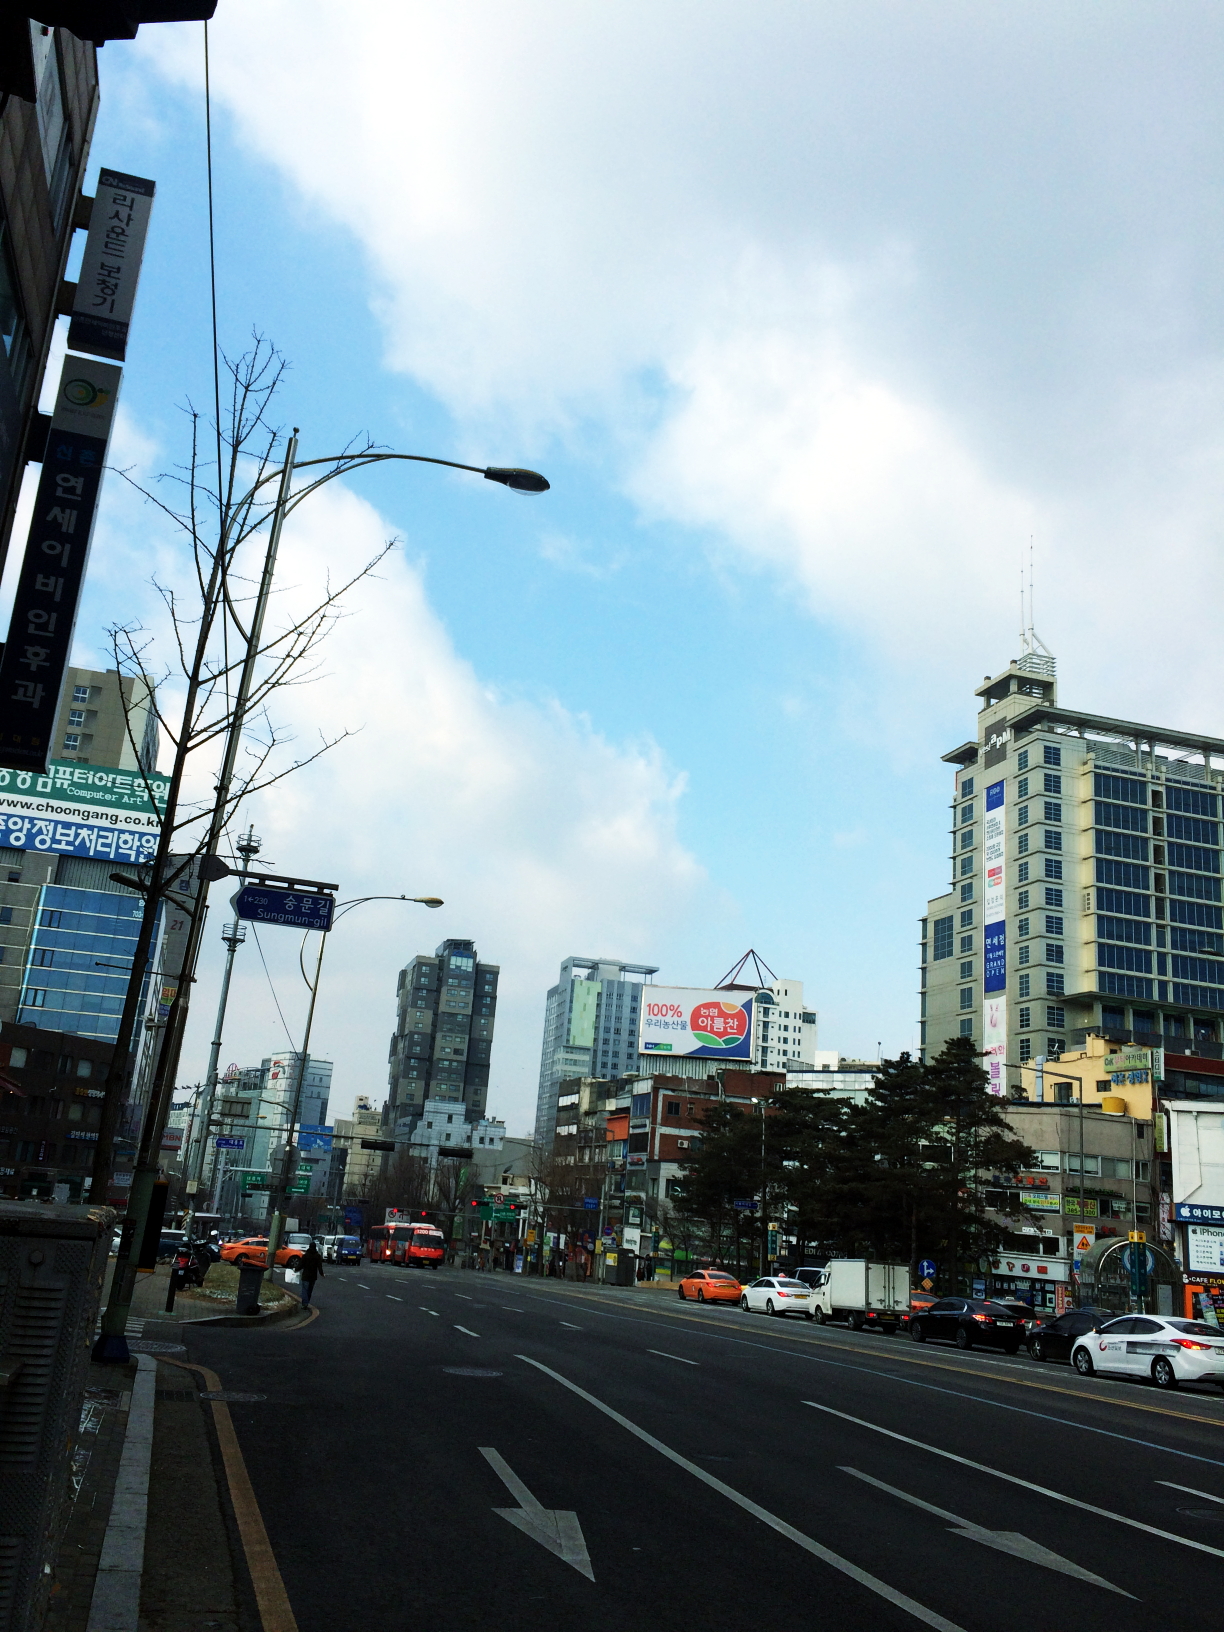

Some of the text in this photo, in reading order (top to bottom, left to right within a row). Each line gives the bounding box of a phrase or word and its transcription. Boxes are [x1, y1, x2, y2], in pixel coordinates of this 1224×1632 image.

[101, 192, 135, 258] 리사운드
[92, 263, 121, 314] 보청기
[10, 473, 86, 710] 연세이비인후과
[66, 786, 143, 805] Computer Art
[283, 895, 331, 916] 숭문길
[256, 908, 328, 928] Sungmun-gil
[985, 933, 1005, 949] 면세점
[986, 958, 1005, 969] GRAND
[986, 967, 1005, 978] OPEN
[646, 1003, 683, 1018] 100%
[700, 1007, 719, 1016] 농협
[645, 1018, 688, 1031] 우리농산물
[698, 1016, 739, 1033] 아름찬
[1192, 1208, 1224, 1219] 아이모
[1191, 1276, 1208, 1284] CAFE
